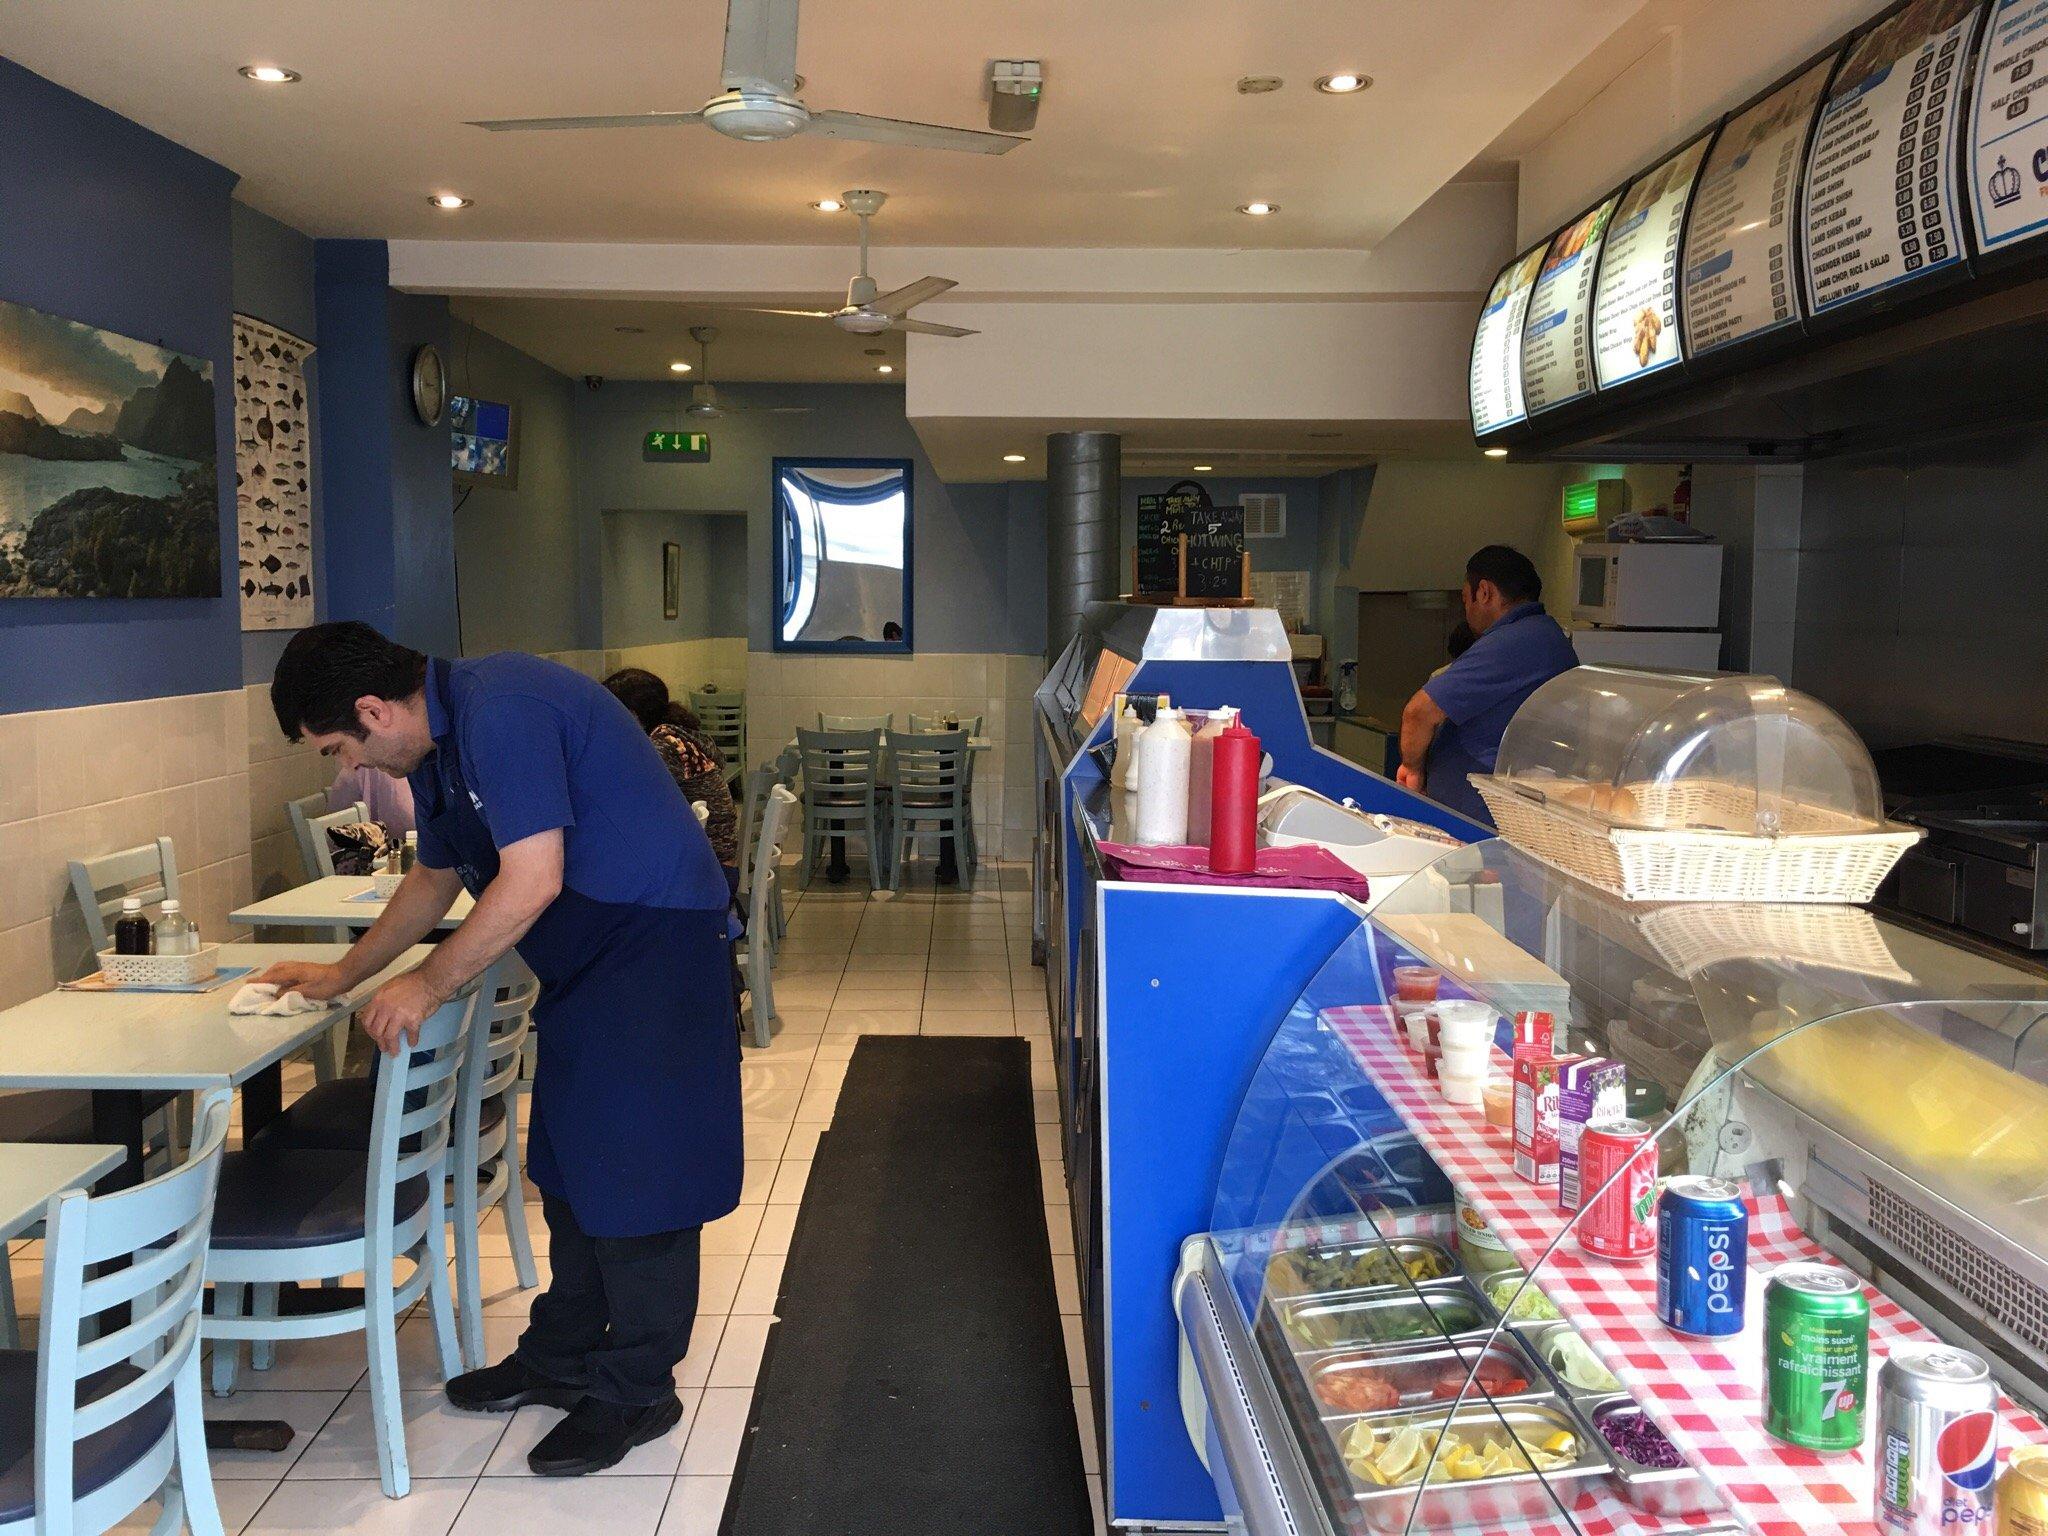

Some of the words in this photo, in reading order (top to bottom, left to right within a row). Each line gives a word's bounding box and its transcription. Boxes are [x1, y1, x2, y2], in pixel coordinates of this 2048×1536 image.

[1991, 93, 2010, 111] HALF
[1812, 188, 1826, 201] LAMB
[1811, 198, 1834, 216] CHICKEN
[1828, 207, 1847, 222] KEBAB
[1811, 232, 1826, 246] LAMB
[1827, 224, 1844, 239] SHISH
[1846, 216, 1862, 230] WRAP
[1812, 243, 1836, 260] CHICKEN
[1837, 235, 1854, 250] SHISH
[1856, 227, 1872, 242] WRAP
[1814, 257, 1840, 275] ISKENDER
[1841, 249, 1860, 264] KEBAB
[1816, 278, 1831, 290] LAMB
[1849, 264, 1864, 277] RICE
[1870, 254, 1890, 268] SALAD
[1843, 282, 1860, 296] WRAP
[1714, 320, 1728, 332] ONION
[1191, 510, 1218, 525] TAKE
[1160, 520, 1171, 535] 2
[1208, 523, 1222, 535] 5
[1703, 1225, 1734, 1314] pepsi
[1801, 1334, 1830, 1345] moins
[1814, 1346, 1833, 1354] pour
[1802, 1352, 1858, 1366] vraiment
[1778, 1358, 1862, 1378] rafraîchissant
